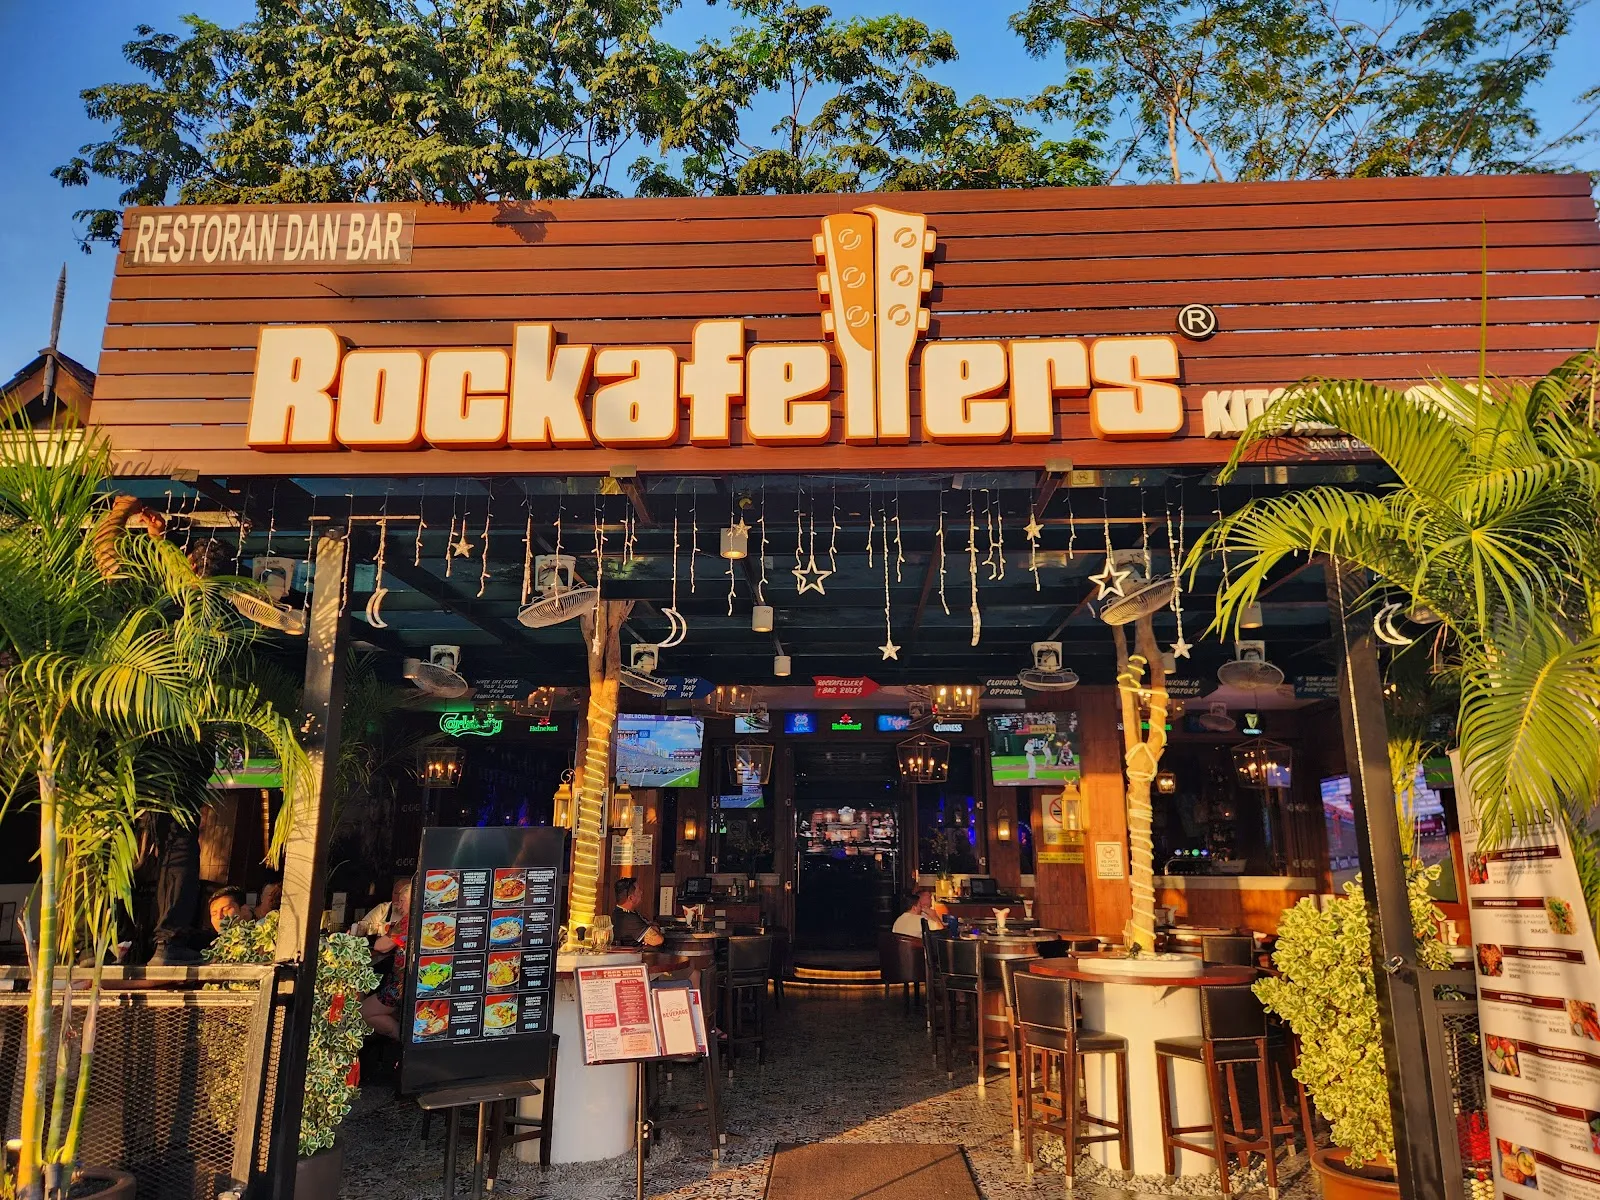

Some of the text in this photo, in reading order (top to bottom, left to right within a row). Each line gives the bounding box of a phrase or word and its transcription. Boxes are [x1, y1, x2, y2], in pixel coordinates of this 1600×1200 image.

[133, 212, 403, 264] RESTORAN DAN BAR
[1166, 679, 1189, 687] INKING
[989, 688, 1023, 696] OPTIONAL
[933, 723, 963, 732] GUINNESS
[586, 1030, 595, 1060] PASTA
